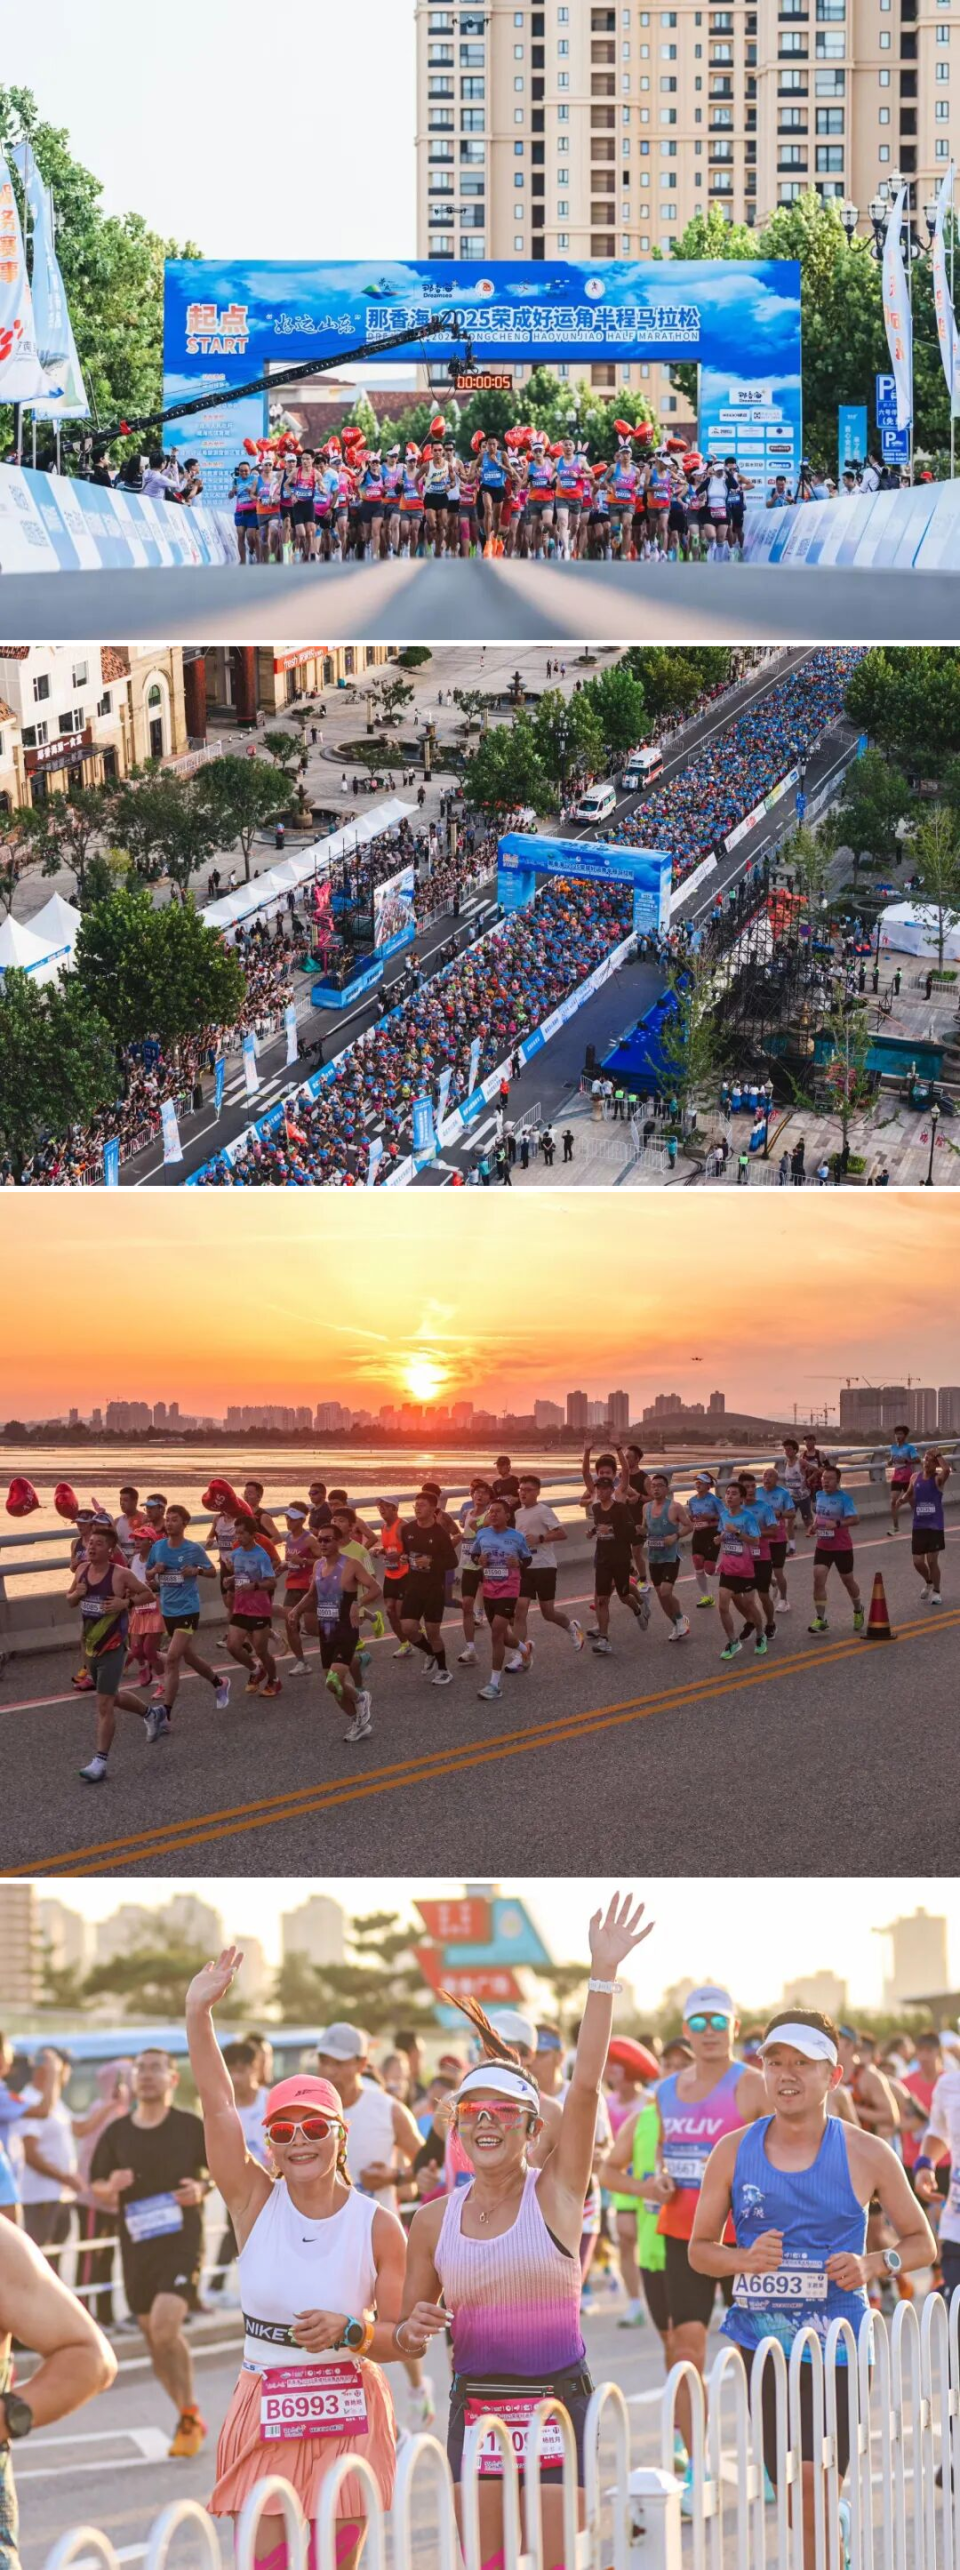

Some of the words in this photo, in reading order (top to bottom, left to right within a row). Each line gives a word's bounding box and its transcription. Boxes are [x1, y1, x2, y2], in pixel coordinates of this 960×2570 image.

[187, 304, 248, 335] 起点
[187, 337, 248, 354] START
[463, 332, 529, 342] ONGCHENG
[533, 332, 603, 342] HAOYUNJIAO
[607, 332, 634, 342] HALF
[639, 332, 700, 342] MARATHON
[457, 376, 511, 389] 00:00:05
[879, 376, 895, 400] P
[885, 431, 897, 447] P
[735, 2273, 802, 2294] A6693
[245, 2320, 288, 2342] NIKE
[266, 2394, 339, 2420] B6993
